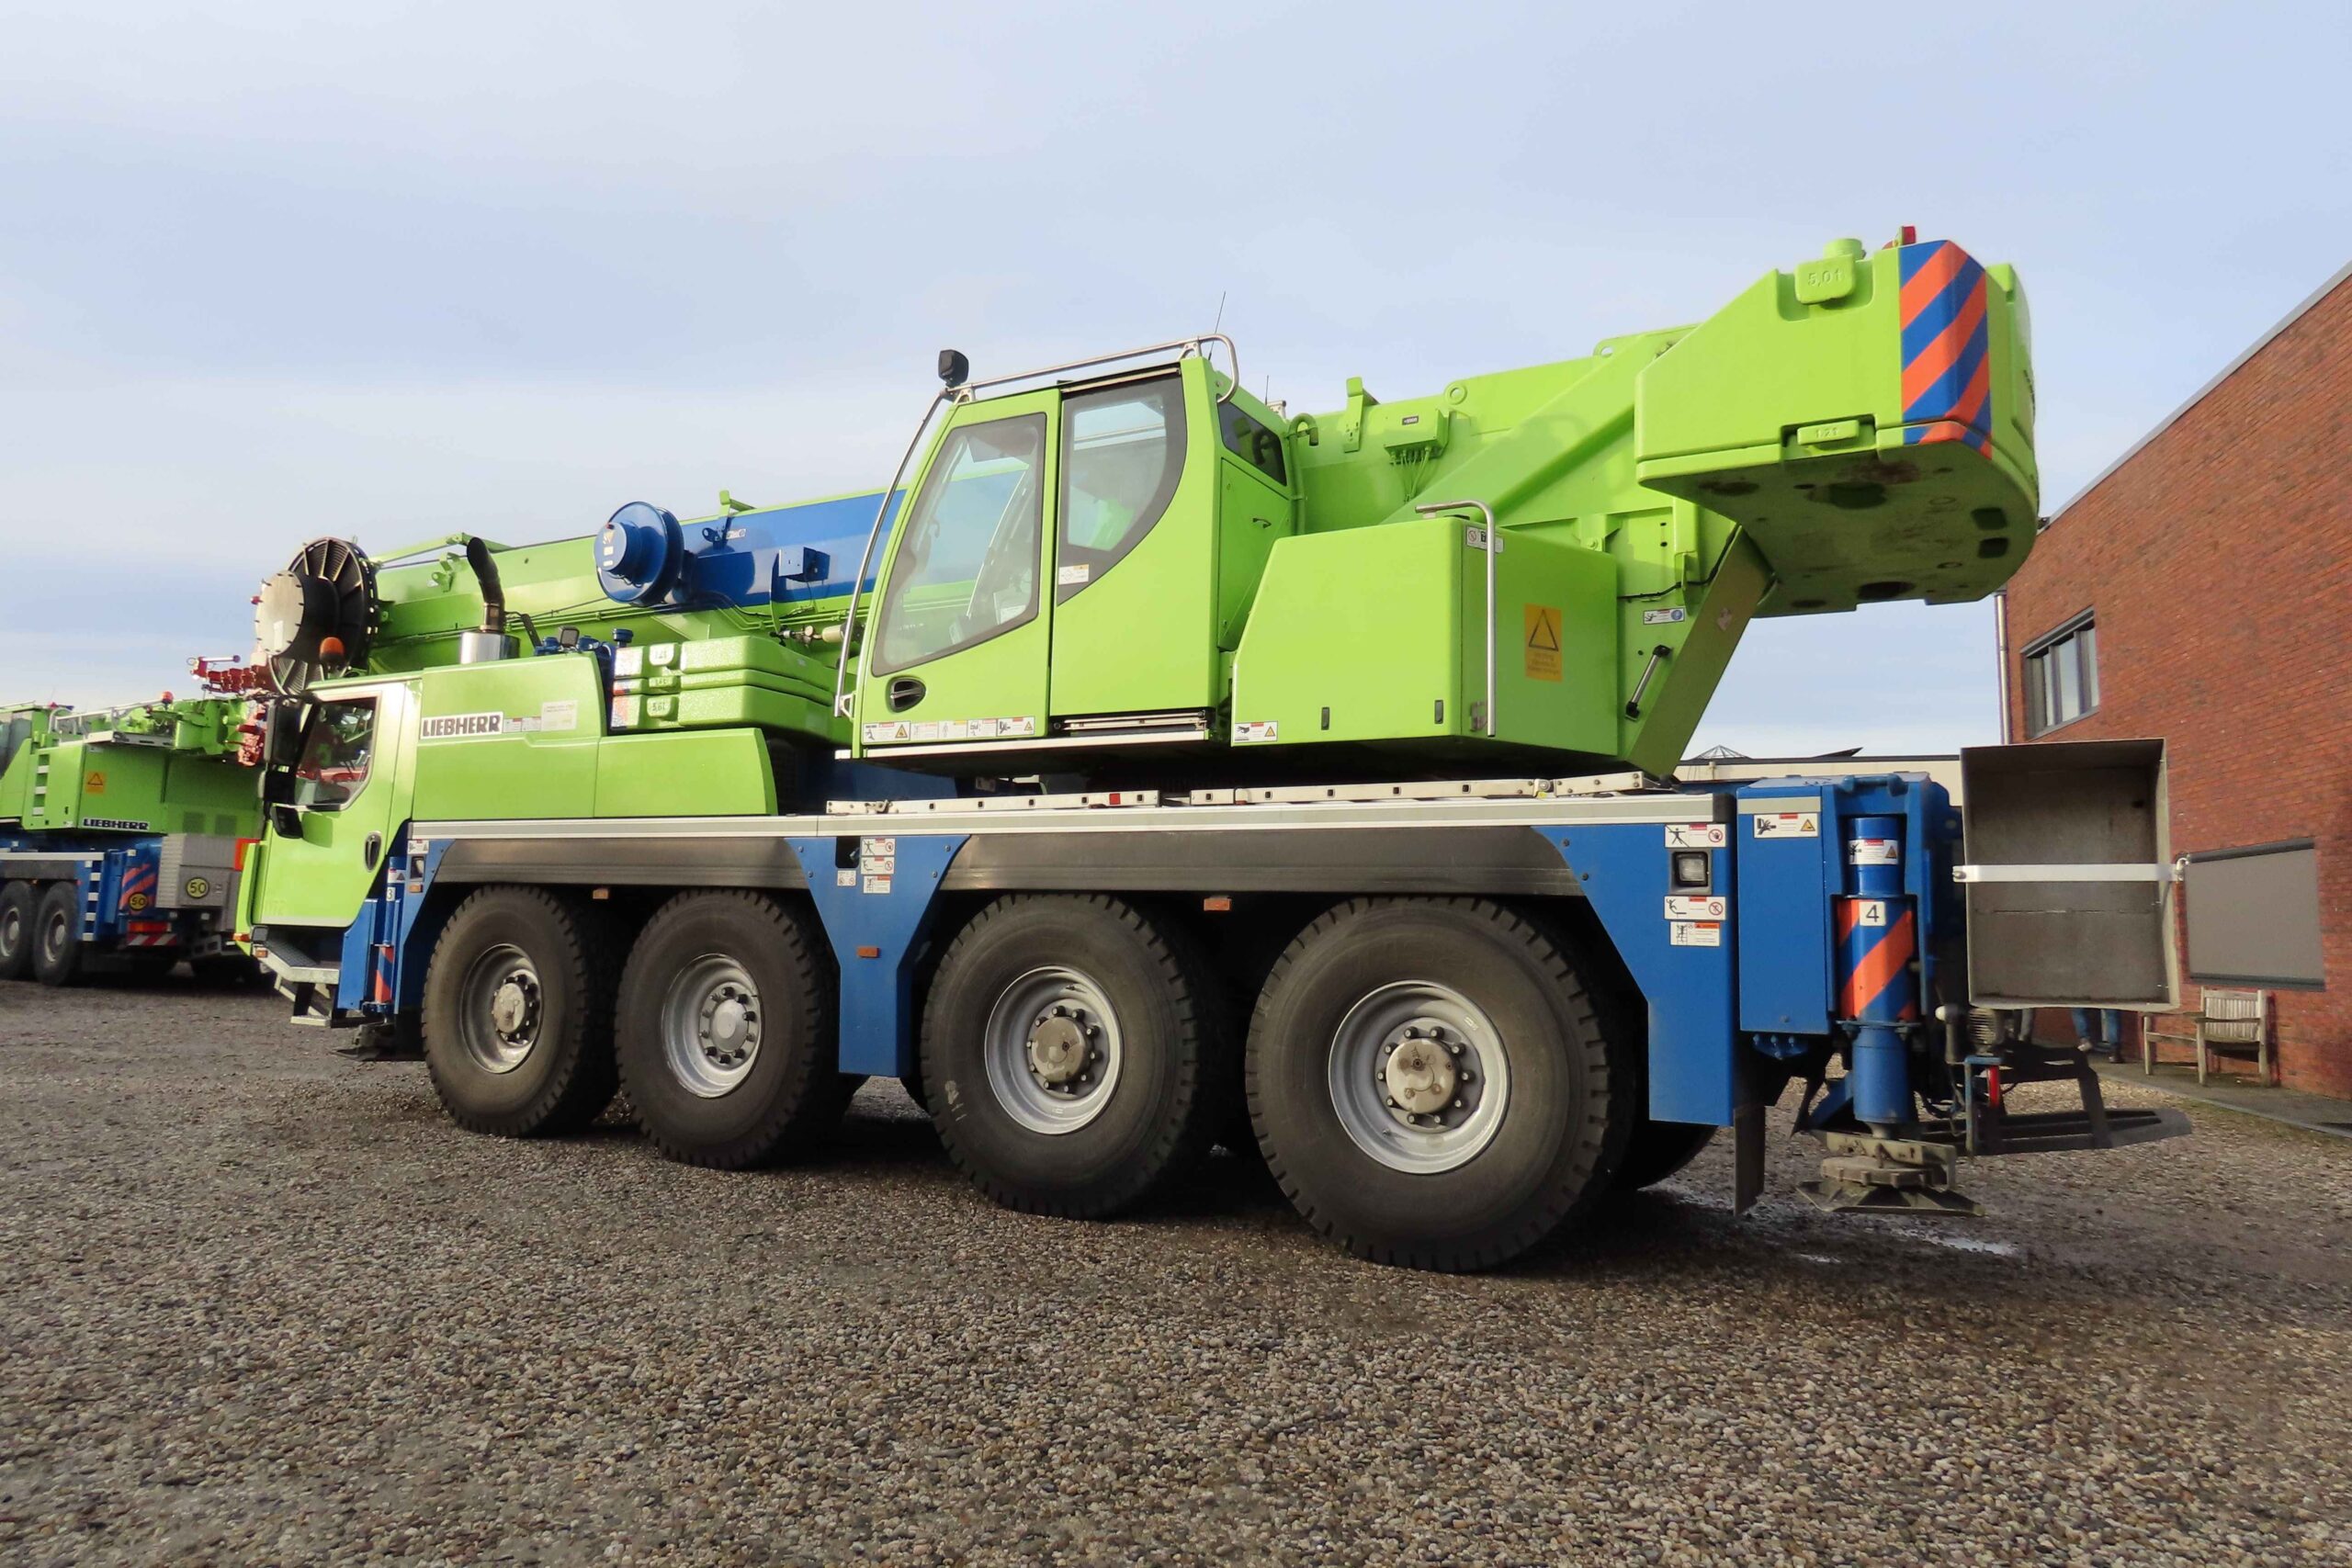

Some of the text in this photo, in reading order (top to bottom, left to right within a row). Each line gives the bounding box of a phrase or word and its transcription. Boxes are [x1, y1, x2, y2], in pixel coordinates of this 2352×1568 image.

[423, 715, 501, 737] LIEBHERR
[84, 818, 148, 829] LIEBHERR
[189, 883, 207, 894] 50
[387, 888, 393, 899] 3
[131, 897, 146, 906] 50
[1865, 904, 1880, 922] 4
